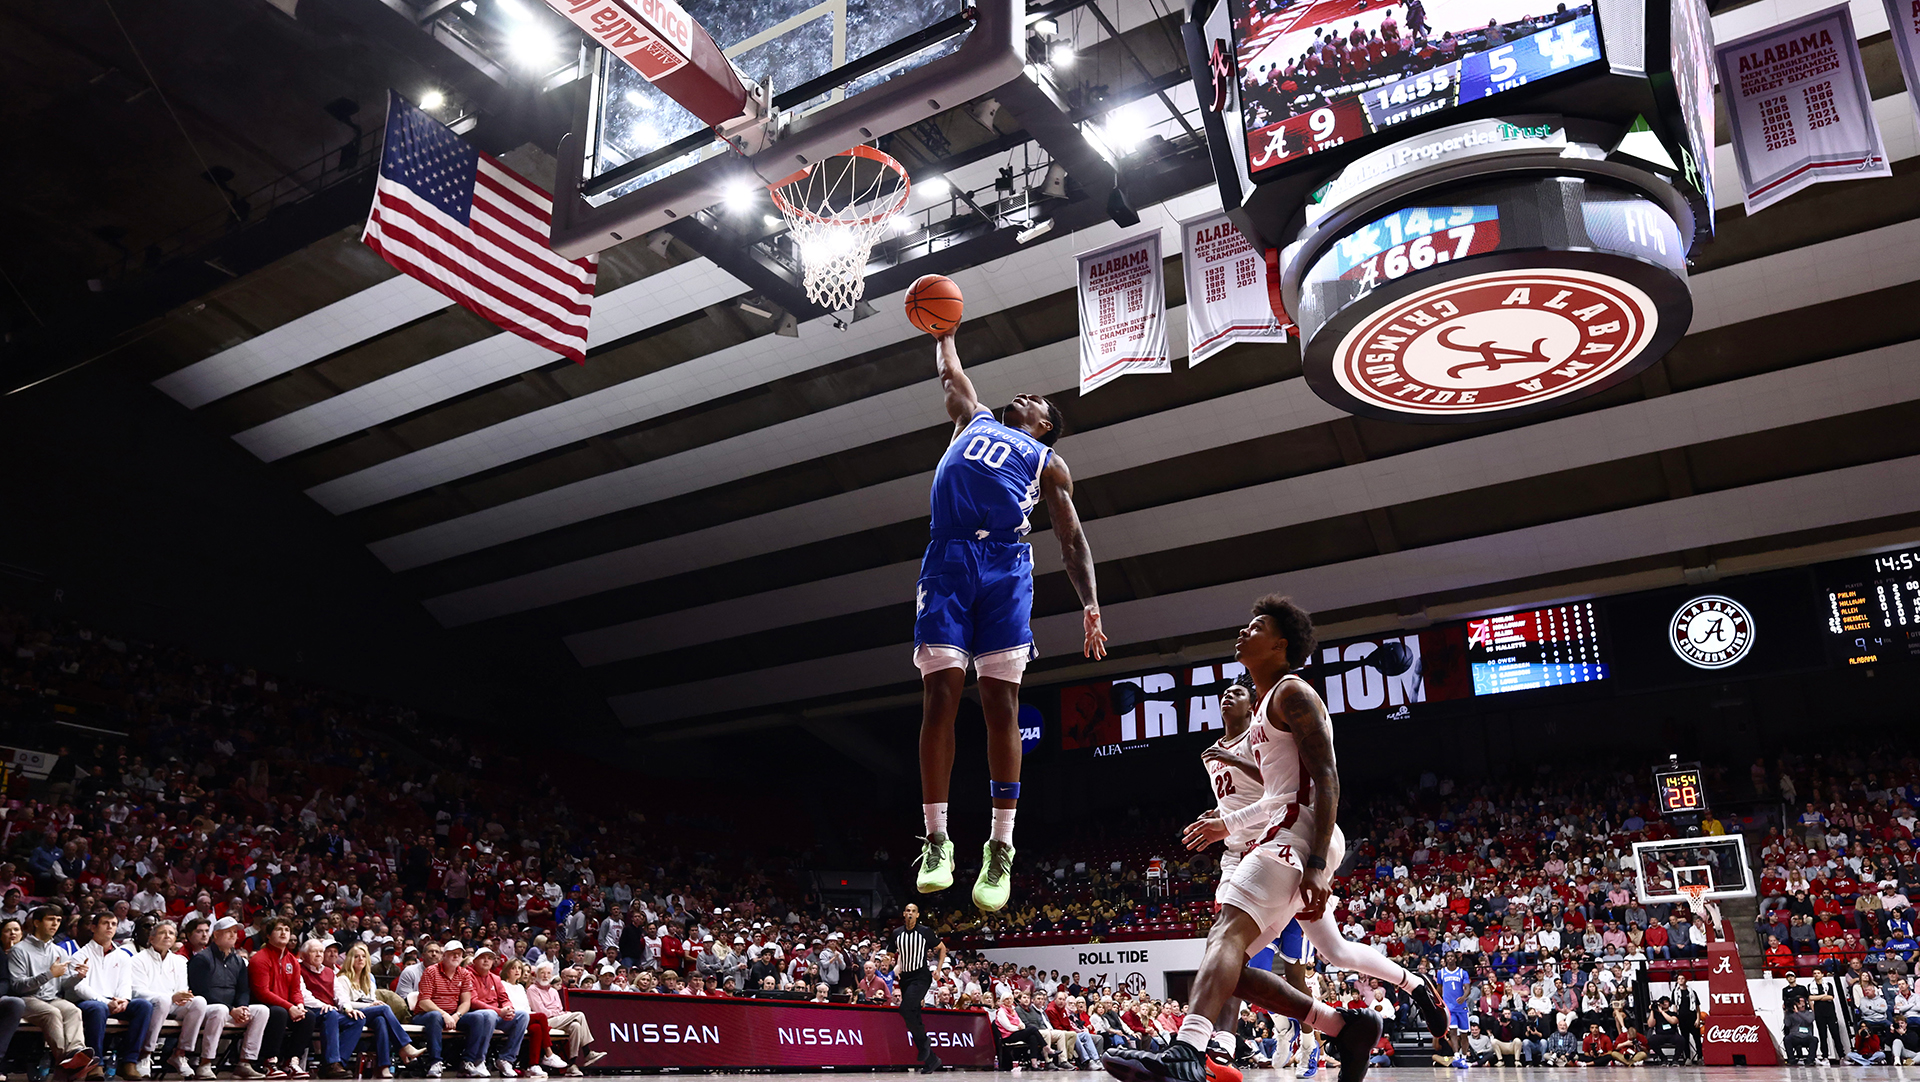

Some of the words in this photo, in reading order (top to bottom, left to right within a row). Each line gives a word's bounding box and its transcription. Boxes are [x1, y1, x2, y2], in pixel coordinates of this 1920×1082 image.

[590, 6, 650, 48] Alfa
[1739, 29, 1833, 73] ALABAMA
[1488, 45, 1518, 83] 5
[1740, 67, 1770, 82] MEN'S
[1773, 47, 1836, 72] BASKETBALL
[1741, 77, 1768, 89] NCAA
[1769, 53, 1838, 80] TOURNAMENT
[1485, 87, 1493, 97] 2
[1497, 75, 1528, 93] TFLS
[1742, 78, 1784, 97] SWEET
[1788, 60, 1840, 83] SIXTEEN
[1377, 69, 1450, 110] 14:55
[1802, 81, 1832, 96] 1982
[1804, 89, 1834, 104] 1986
[1759, 95, 1787, 109] 1976
[1760, 103, 1789, 118] 1985
[1806, 98, 1834, 113] 1991
[1384, 111, 1408, 126] 1ST
[1410, 98, 1447, 118] HALF
[1762, 111, 1791, 126] 1990
[1807, 106, 1837, 122] 2021
[1309, 108, 1336, 142] 9
[1763, 120, 1793, 135] 2004
[1809, 114, 1840, 130] 2024
[1399, 128, 1497, 166] Properties
[1497, 122, 1551, 140] Trust
[1764, 128, 1795, 143] 2023
[1766, 136, 1797, 152] 2025
[1307, 146, 1314, 155] 1
[1318, 137, 1344, 152] TFLS
[1624, 207, 1667, 256] FT%
[1195, 242, 1216, 253] MEN'S
[1197, 250, 1210, 258] SEC
[1212, 239, 1249, 254] TOURNAM
[1205, 244, 1253, 263] CHAMPIONS
[1384, 224, 1476, 280] 66.7
[1089, 249, 1149, 279] ALABAMA
[1235, 256, 1255, 268] 1934
[1236, 263, 1255, 274] 1987
[1089, 275, 1109, 286] MEN'S
[1110, 263, 1149, 280] BASKETBALL
[1205, 266, 1225, 276] 1930
[1205, 273, 1225, 283] 1982
[1236, 270, 1256, 281] 1990
[1088, 284, 1099, 292] SEC
[1100, 277, 1127, 289] REGULAR
[1128, 269, 1151, 280] SEASON
[1098, 278, 1142, 297] CHAMPIONS
[1206, 279, 1225, 290] 1989
[1236, 277, 1257, 288] 2021
[1206, 286, 1225, 296] 1991
[1206, 293, 1226, 303] 2023
[1100, 322, 1128, 333] WESTERN
[1100, 323, 1145, 340] CHAMPIONS
[1365, 299, 1460, 388] CRIMSON
[1501, 287, 1621, 393] ALABAMA
[1393, 382, 1479, 404] TIDE
[965, 425, 1034, 458] KENTUCKY
[963, 435, 1012, 468] 00
[1906, 581, 1920, 590] 00
[1677, 602, 1744, 631] ALABAMA
[1679, 637, 1727, 662] CRIMSON
[1726, 631, 1746, 655] TIDE
[1855, 637, 1867, 652] 9
[1874, 637, 1883, 646] 4
[1498, 656, 1516, 664] OWEN
[1849, 655, 1877, 665] ALABAMA
[1093, 744, 1123, 758] ALFA
[1215, 770, 1236, 800] 22
[1666, 775, 1697, 788] 14:54
[1668, 786, 1697, 809] 28
[1078, 952, 1114, 965] ROLL
[1117, 950, 1149, 963] TIDE
[1127, 973, 1145, 994] SEC
[1450, 981, 1456, 991] 1
[1711, 993, 1745, 1004] YETI
[609, 1022, 720, 1044] NISSAN
[777, 1027, 863, 1046] NISSAN
[907, 1031, 975, 1048] NSSAN
